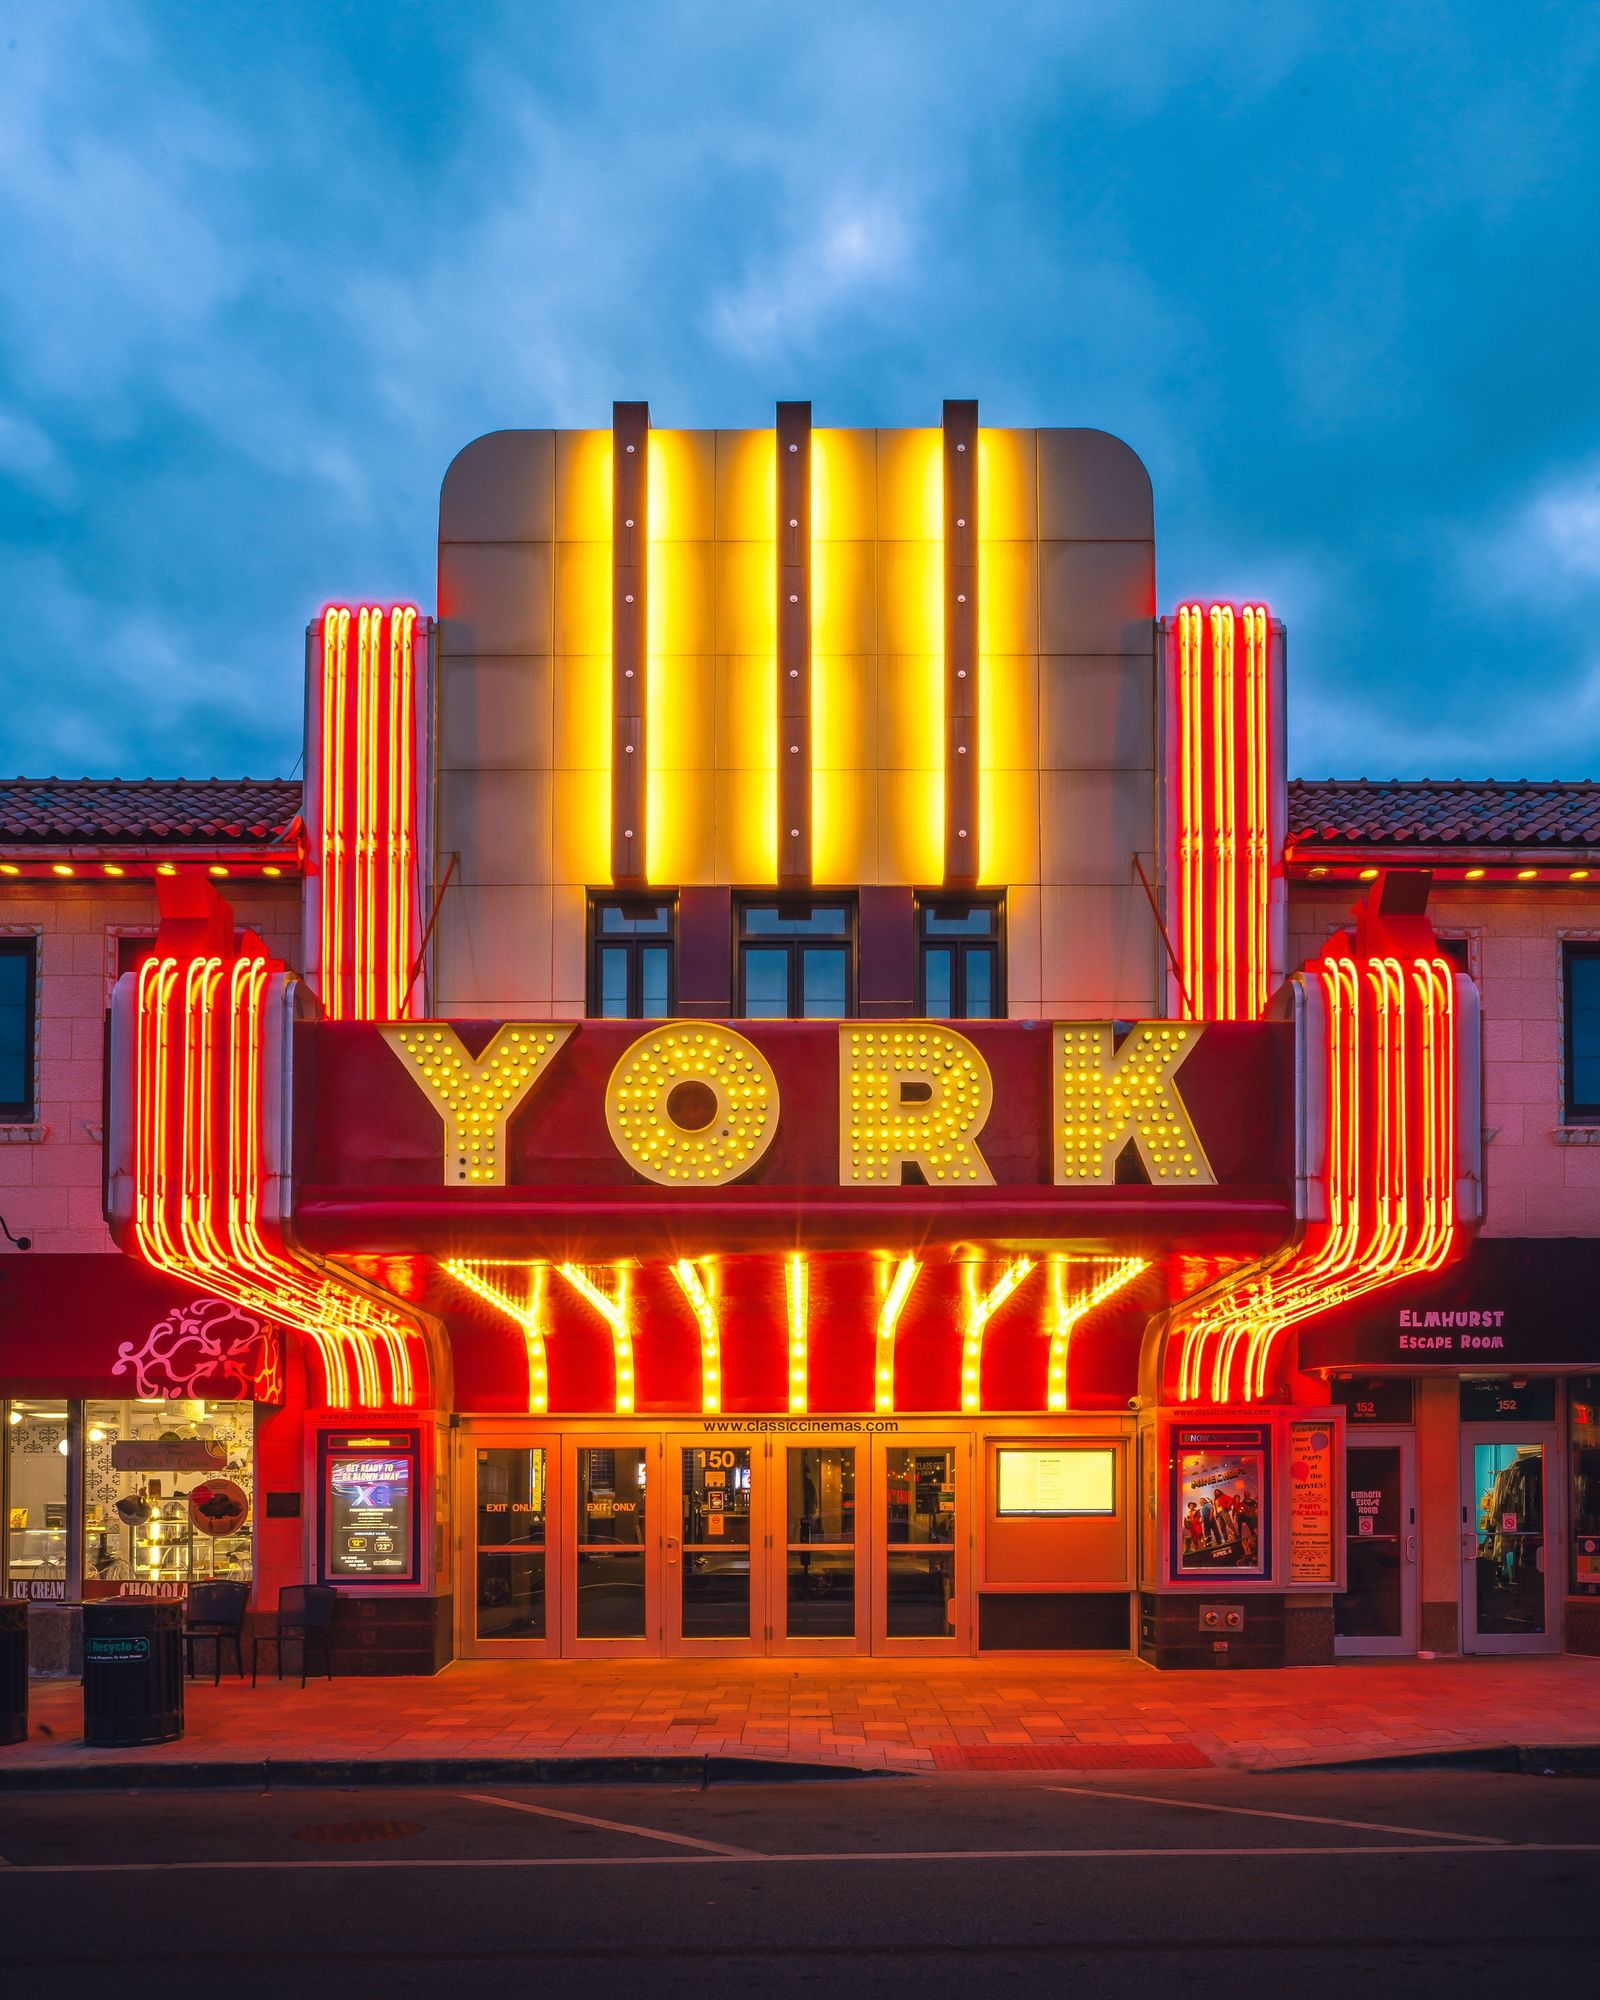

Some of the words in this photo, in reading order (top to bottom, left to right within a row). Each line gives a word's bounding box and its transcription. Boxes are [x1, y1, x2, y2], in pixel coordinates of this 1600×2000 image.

[376, 1020, 1218, 1187] YORK
[1356, 1402, 1374, 1412] 152
[1498, 1400, 1517, 1410] 152
[704, 1420, 898, 1432] www.classiccinemas.com
[1191, 1434, 1209, 1442] NOW
[697, 1450, 735, 1468] 150
[346, 1464, 359, 1473] GET
[360, 1464, 382, 1473] READY
[384, 1464, 393, 1472] TO
[342, 1473, 353, 1481] BE
[353, 1473, 378, 1481] BLOWN
[379, 1473, 399, 1481] AWAY
[486, 1503, 507, 1512] EXIT
[512, 1503, 535, 1512] ONLY
[587, 1503, 606, 1511] EXIT
[613, 1503, 636, 1511] ONLY
[13, 1581, 28, 1599] ICE
[31, 1581, 65, 1600] CREAM
[92, 1641, 132, 1654] Recycle
